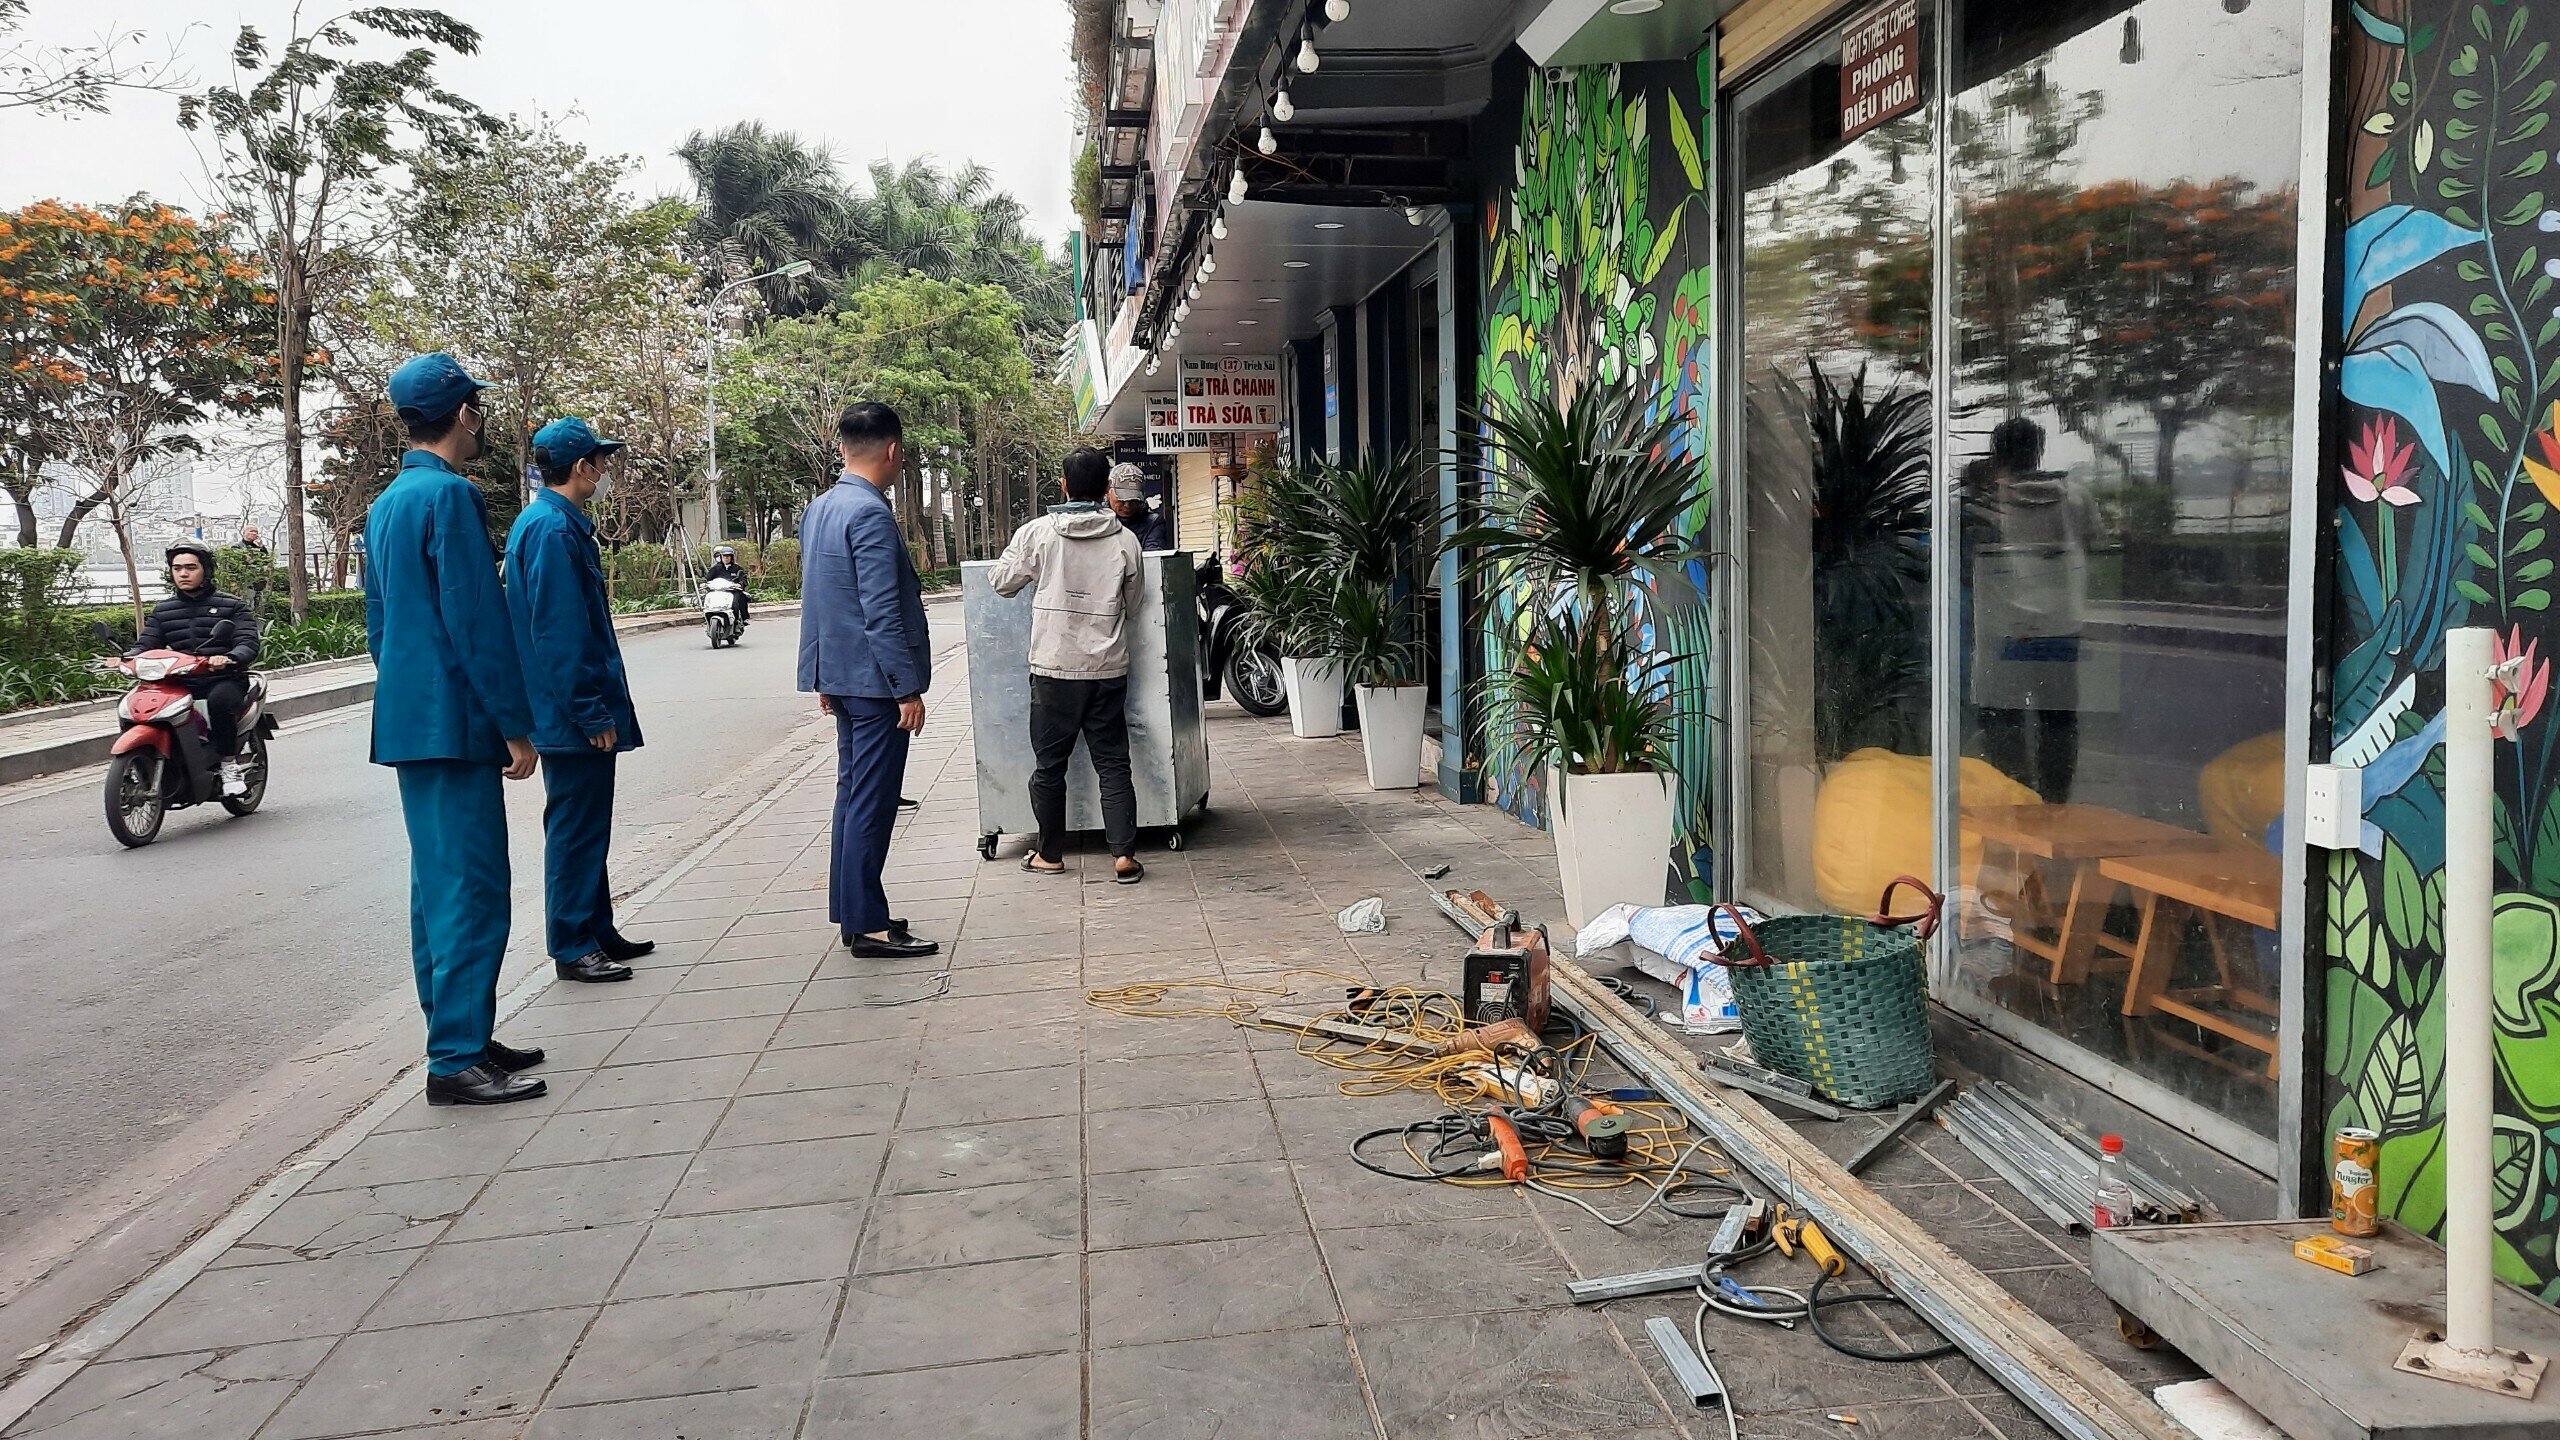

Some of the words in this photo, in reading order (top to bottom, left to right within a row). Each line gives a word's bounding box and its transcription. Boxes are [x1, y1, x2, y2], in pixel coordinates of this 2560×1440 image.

[1842, 32, 1862, 67] NIGHT
[1862, 14, 1889, 56] STREET
[1889, 0, 1916, 39] COFFEE
[1851, 44, 1905, 95] PHÒNG
[1881, 74, 1915, 113] HÒA
[1223, 360, 1238, 371] 137
[1206, 374, 1230, 396] TRÀ
[1233, 377, 1275, 396] CHANH
[1187, 403, 1217, 424] TRÀ
[1222, 402, 1253, 424] SỮA
[1152, 432, 1185, 450] THẠCH
